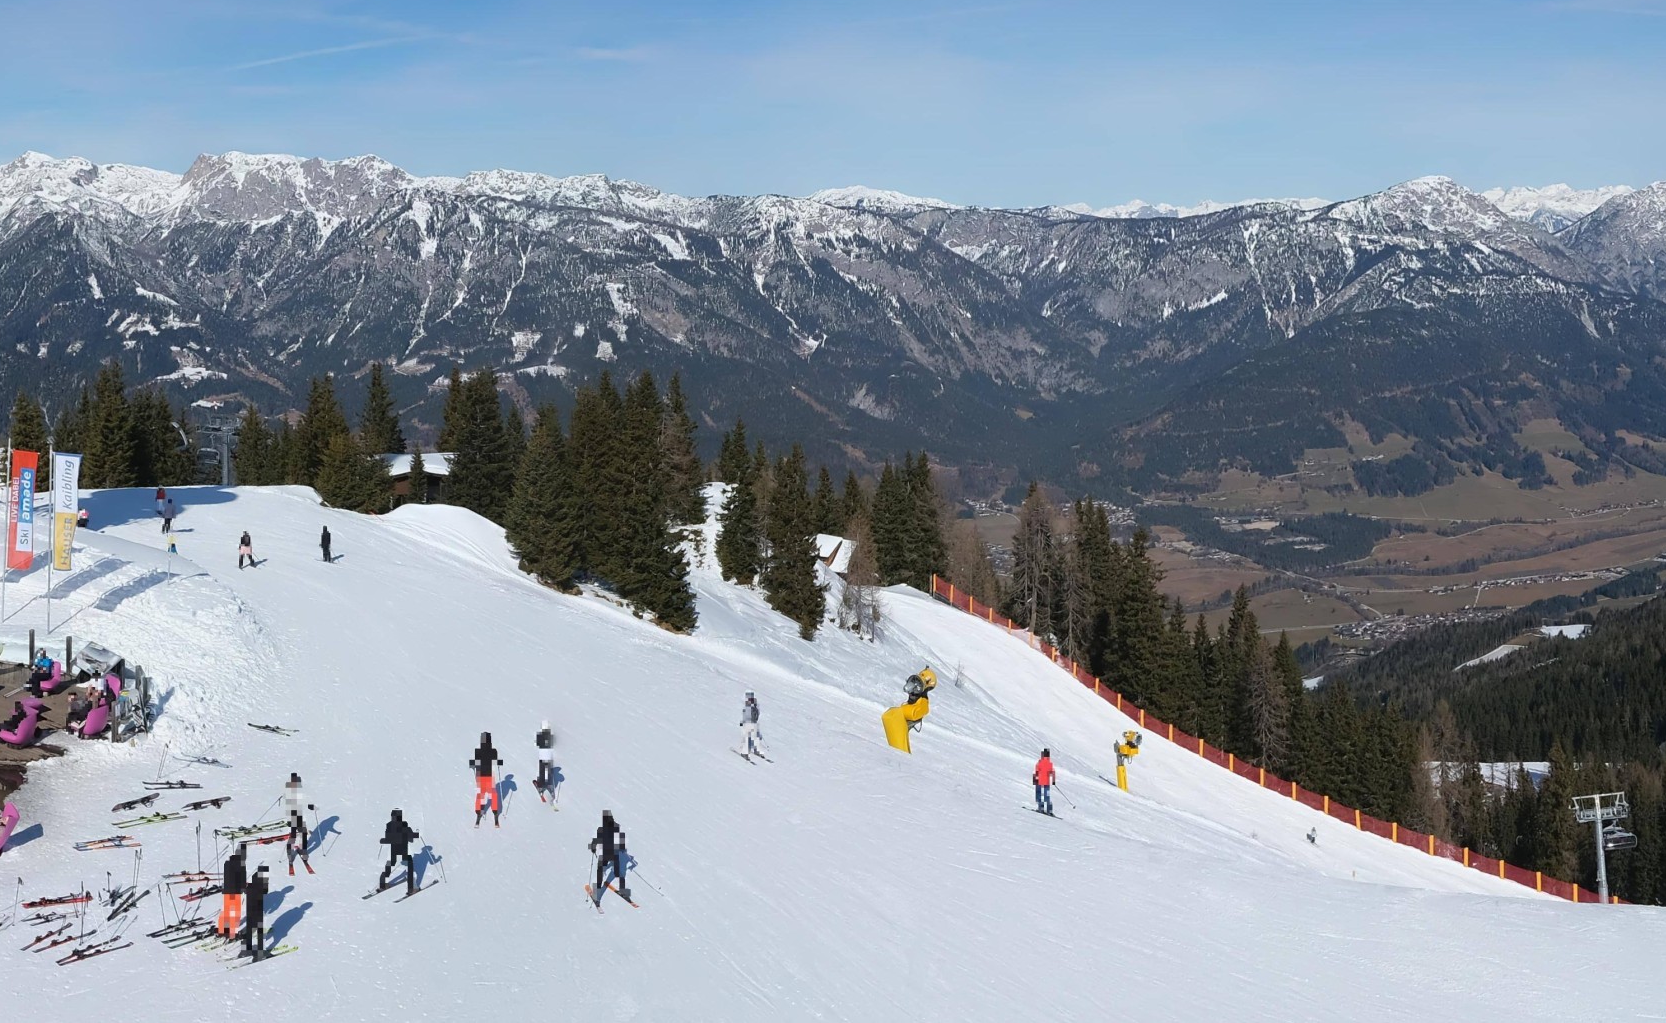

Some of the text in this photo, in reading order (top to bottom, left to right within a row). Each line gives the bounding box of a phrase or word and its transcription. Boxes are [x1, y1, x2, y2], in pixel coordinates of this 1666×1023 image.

[10, 476, 20, 523] LIVE DABEI
[60, 460, 76, 565] HAUSER Kaibling
[20, 530, 29, 544] Ski
